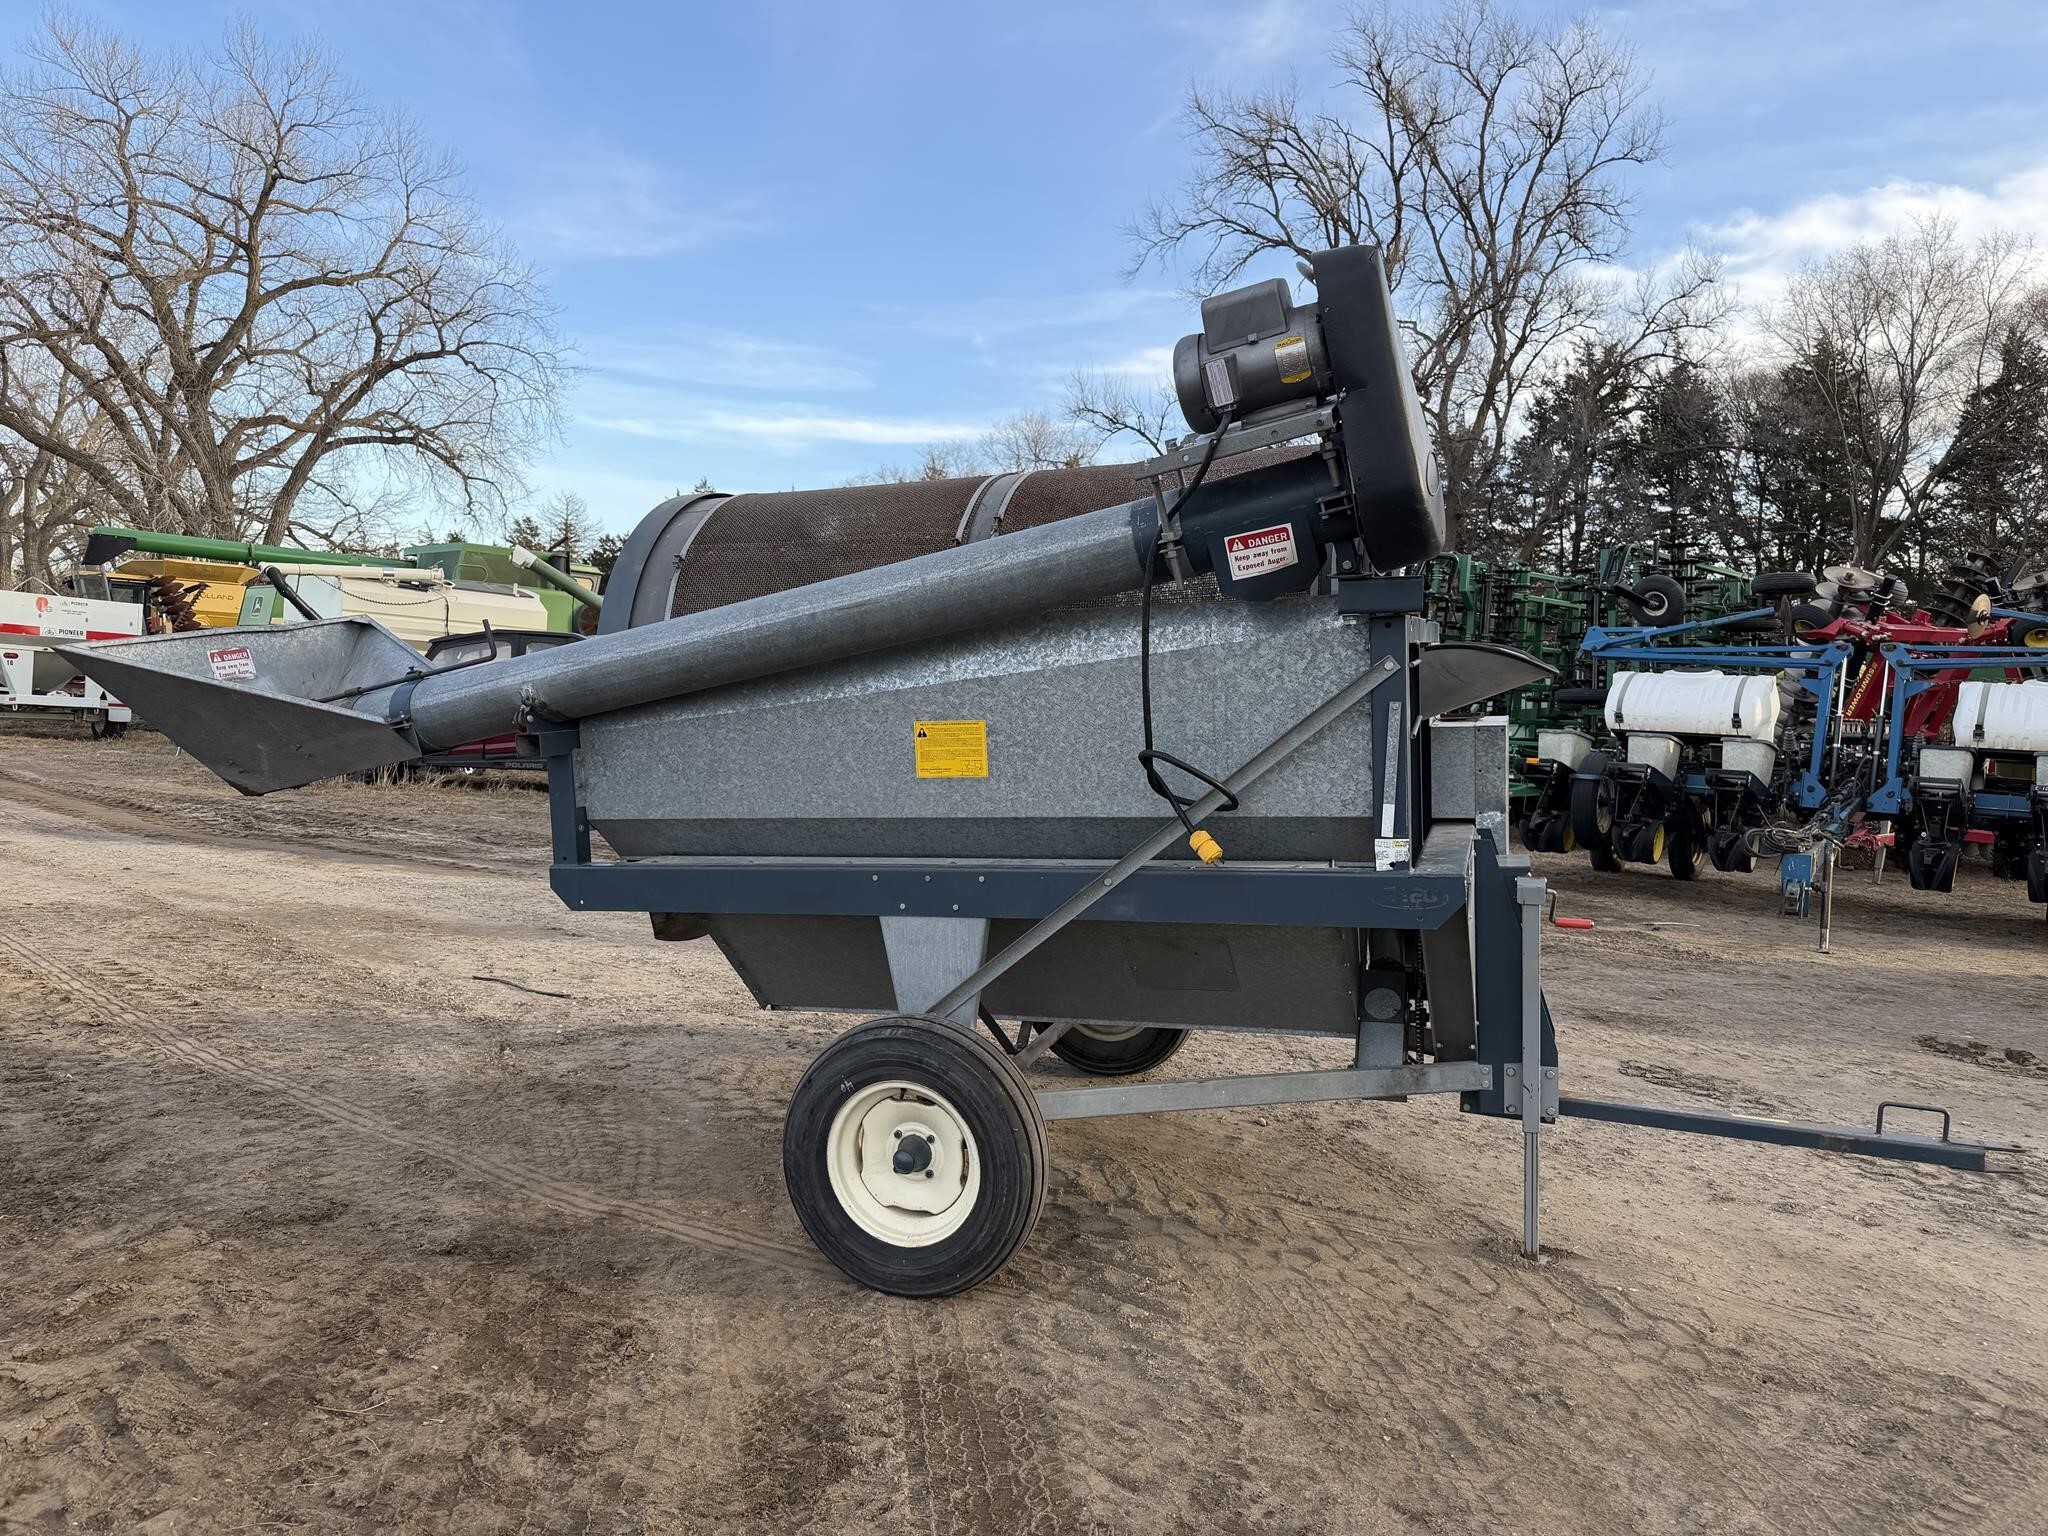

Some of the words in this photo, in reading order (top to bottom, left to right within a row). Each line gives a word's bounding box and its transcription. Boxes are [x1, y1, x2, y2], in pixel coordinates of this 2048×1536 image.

[1248, 532, 1288, 548] DANGER
[1234, 555, 1250, 563] Keep
[1253, 550, 1269, 559] away
[1271, 546, 1288, 554] from
[1238, 560, 1265, 572] Exposed
[1267, 556, 1289, 565] Auger.
[200, 593, 235, 601] OLLAND
[58, 628, 84, 636] PIONEER
[223, 651, 249, 662] DANGER
[1845, 668, 1876, 717] SUNFLOWER
